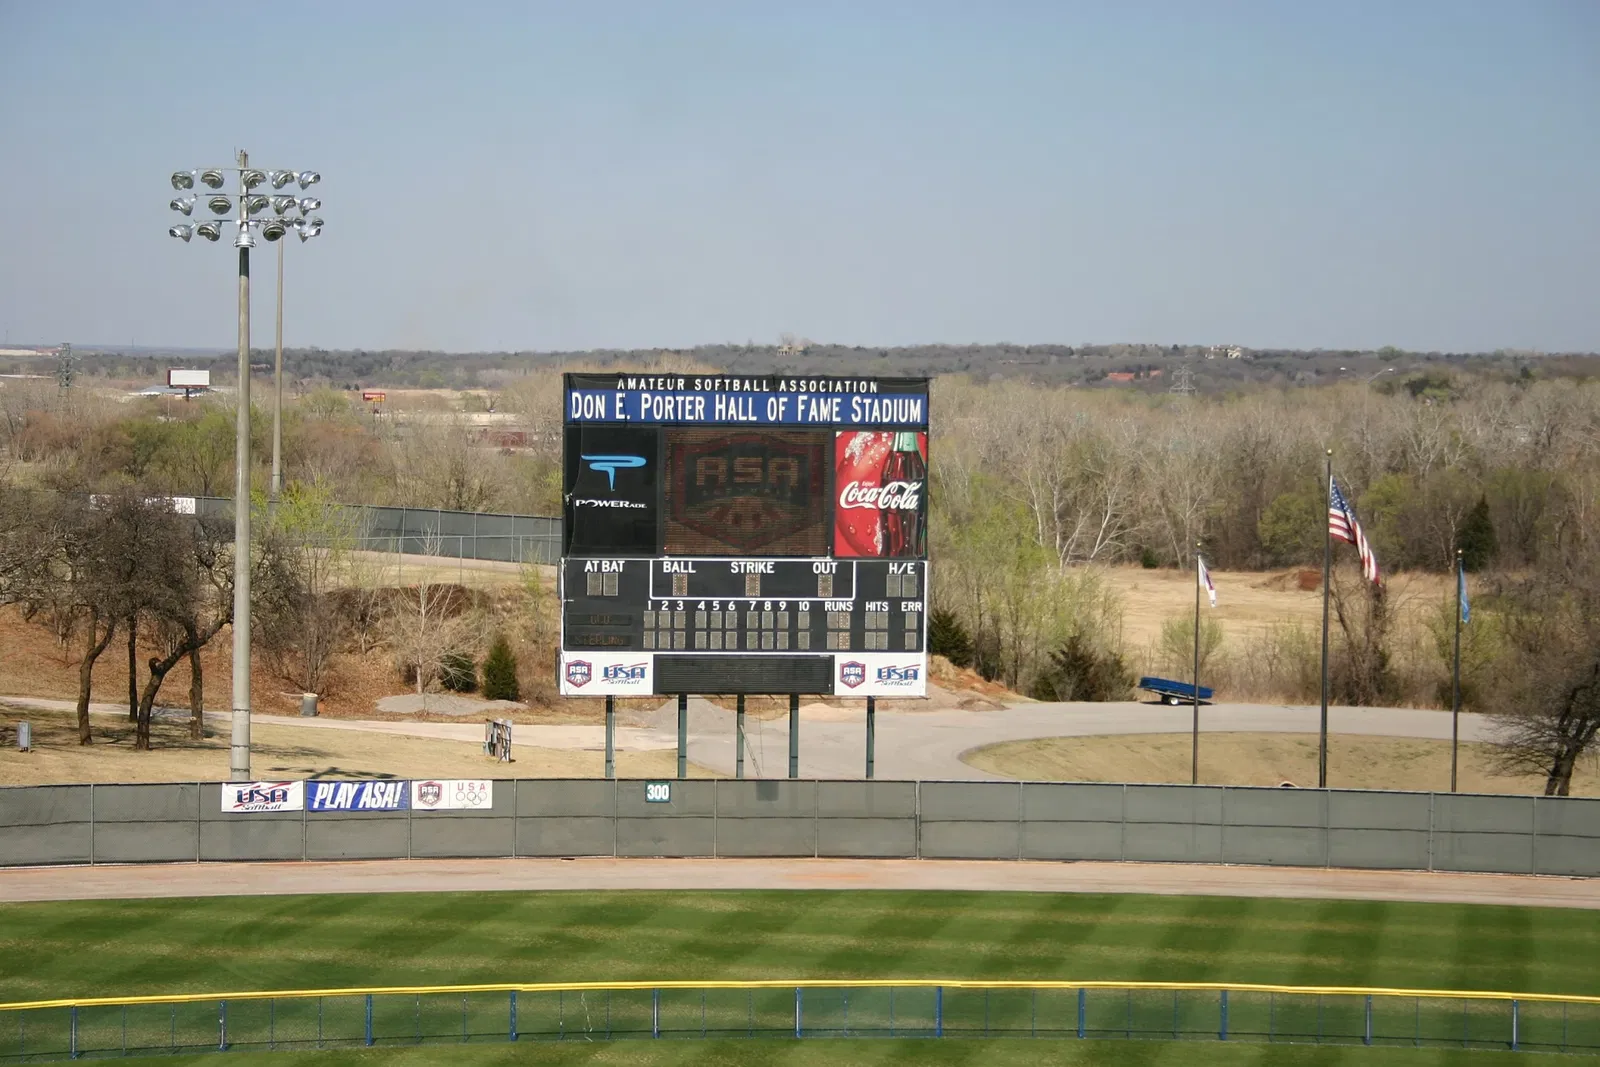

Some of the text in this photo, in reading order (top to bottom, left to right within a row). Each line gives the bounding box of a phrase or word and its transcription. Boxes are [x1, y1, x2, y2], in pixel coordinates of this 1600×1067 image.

[617, 378, 878, 393] AMATEUR SOFTBALL ASSOCIATION
[571, 392, 921, 423] DON E. PORTER HALL OF FAME STADIUM
[696, 457, 799, 486] ASA
[840, 481, 922, 509] Coca-Cola
[584, 561, 625, 573] AT BAT
[663, 561, 696, 574] BALL
[730, 562, 775, 574] STRIKE
[812, 562, 838, 574] OUT
[889, 563, 915, 575] H/E
[647, 600, 922, 612] 1 2 3 4 5 6 7 8 9 10 RUNS HITS ERR
[569, 666, 588, 674] ASA
[603, 666, 647, 679] USA
[843, 667, 862, 675] ASA
[877, 667, 919, 681] USA
[421, 786, 439, 795] ASA
[457, 782, 486, 791] USA
[647, 784, 670, 800] 300
[236, 788, 289, 803] USA
[313, 782, 402, 809] PLAY ASA!
